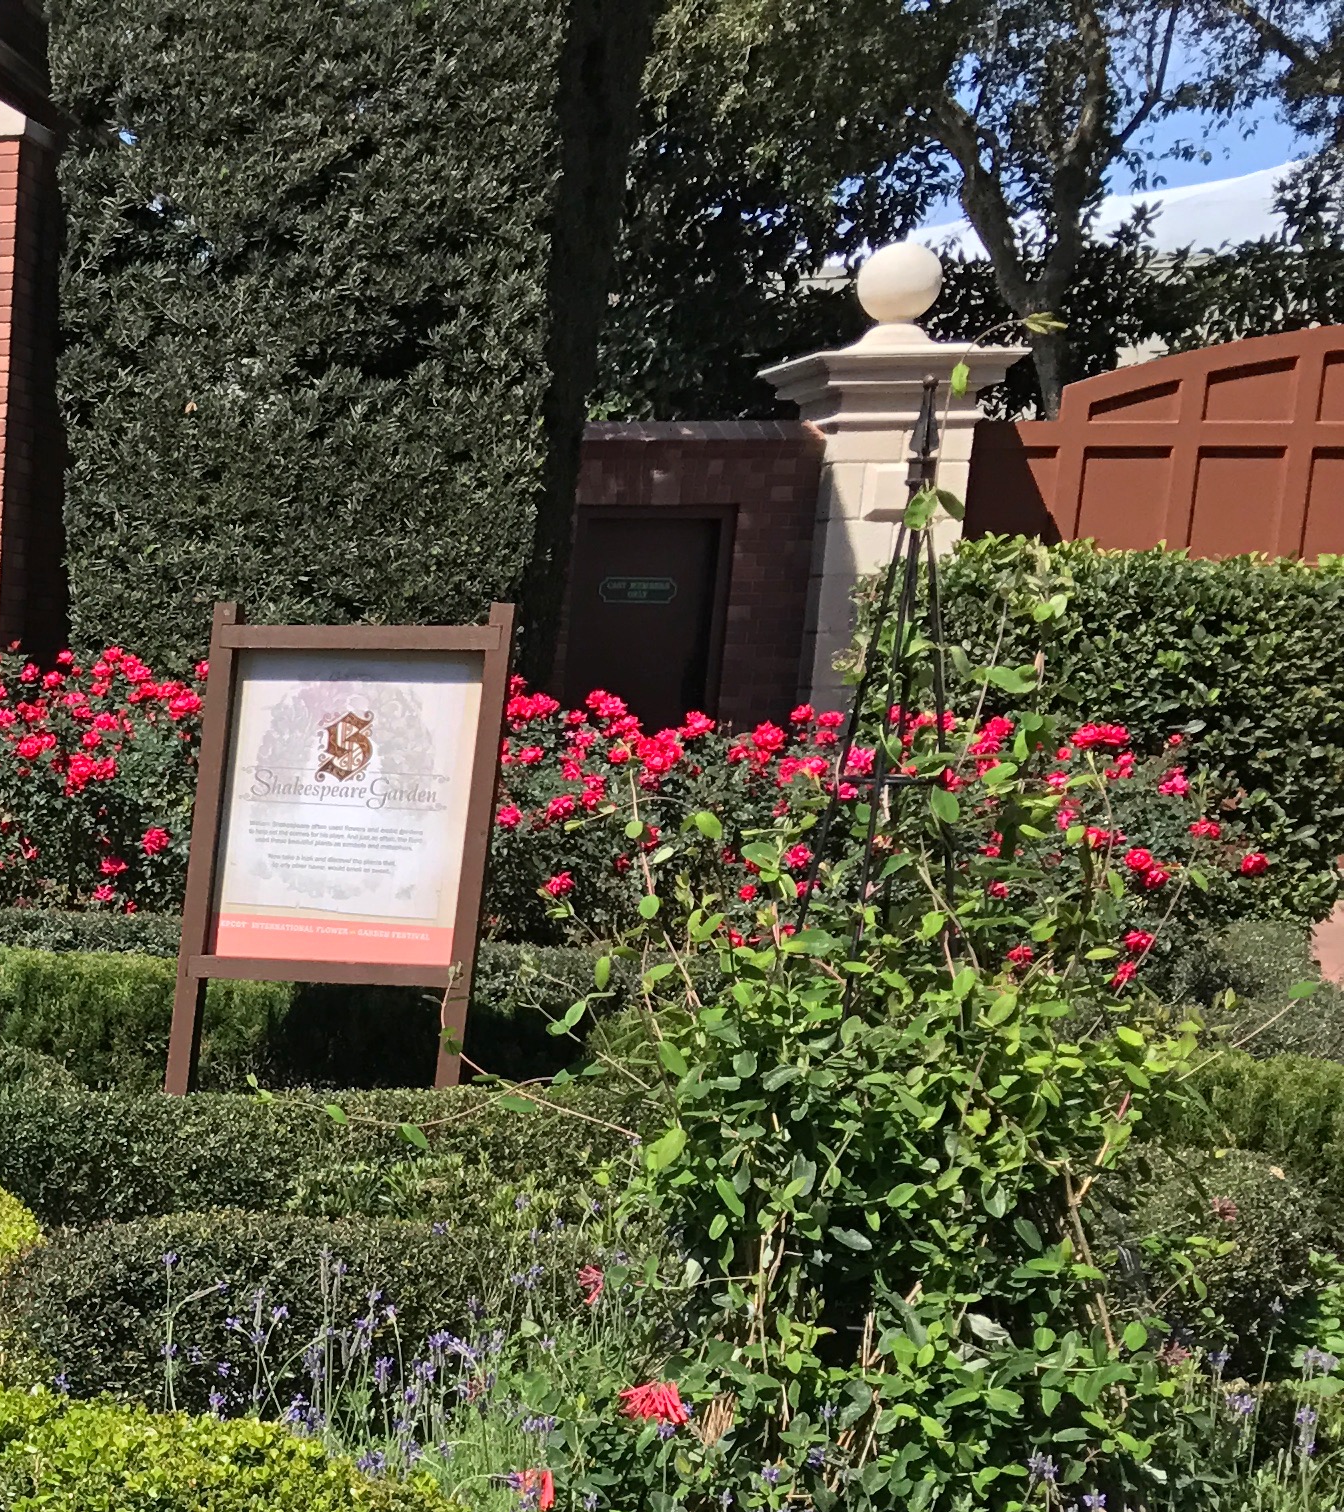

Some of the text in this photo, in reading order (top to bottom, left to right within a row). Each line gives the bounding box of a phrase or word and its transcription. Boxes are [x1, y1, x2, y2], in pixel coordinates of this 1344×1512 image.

[250, 769, 437, 810] Shakespeare Garden
[251, 922, 314, 933] INTERNATIONAL
[391, 931, 430, 941] FESTIVAL
